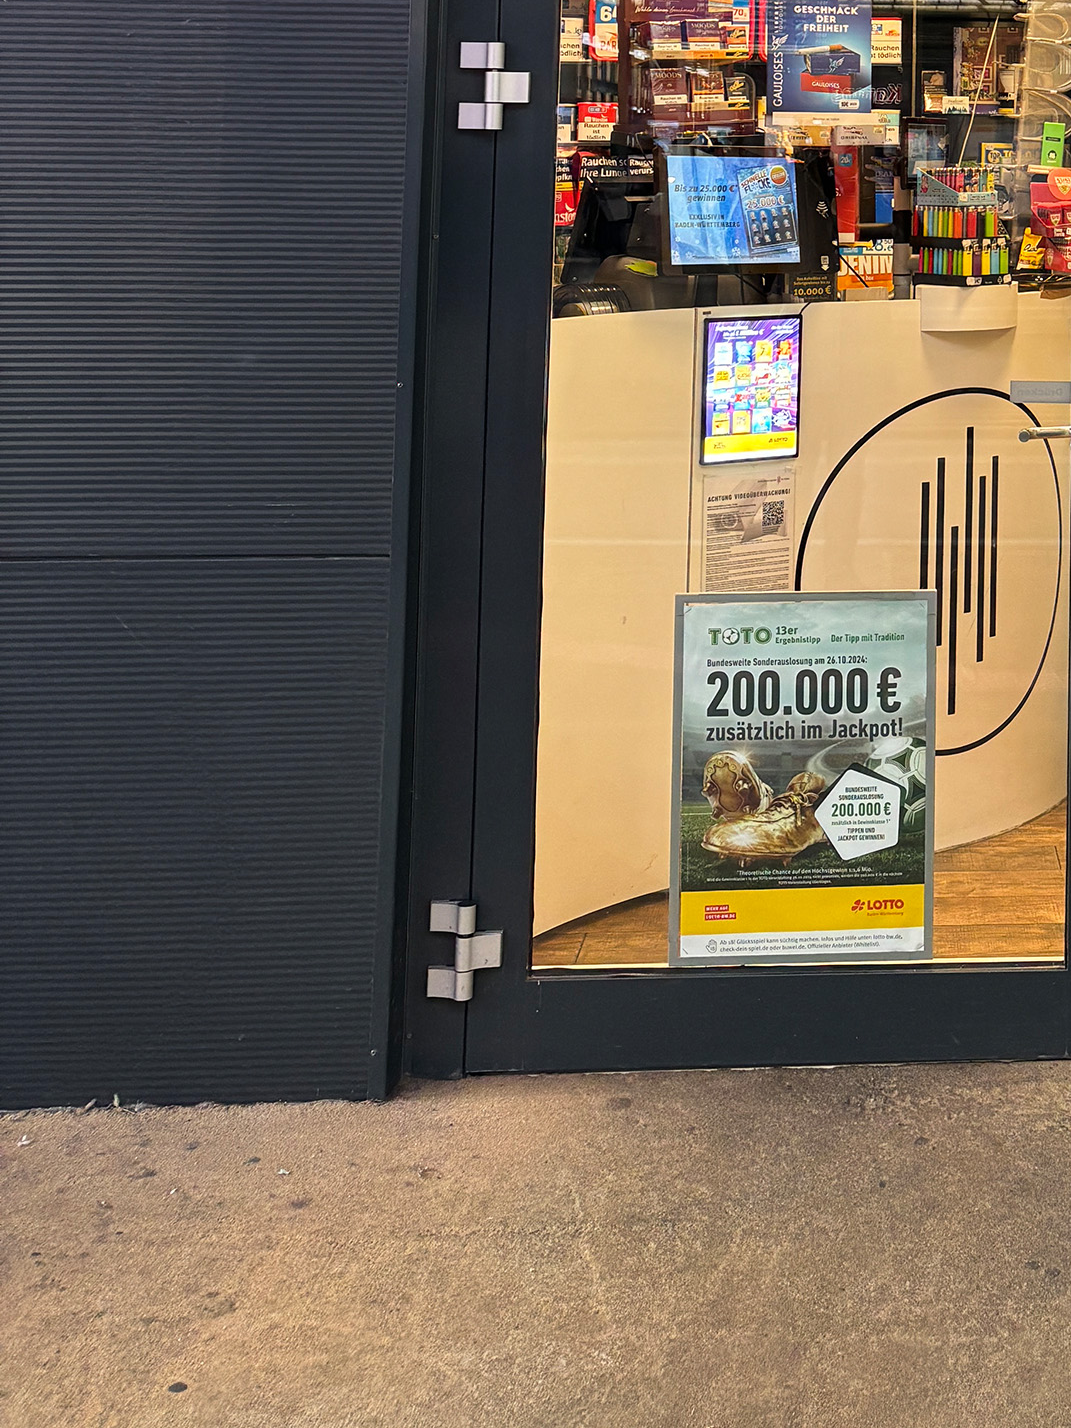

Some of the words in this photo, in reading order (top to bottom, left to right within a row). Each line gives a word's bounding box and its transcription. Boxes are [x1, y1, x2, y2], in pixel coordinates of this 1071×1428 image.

[794, 6, 858, 15] GESCHMACK
[816, 15, 836, 24] DER
[803, 24, 849, 33] FREIHEIT
[773, 51, 784, 107] GAULOISES
[687, 194, 726, 203] gewinnen
[793, 287, 824, 296] 10.000
[708, 626, 772, 646] TOTO
[776, 626, 798, 636] 13er
[776, 636, 821, 645] Ergebnistipp
[831, 634, 845, 642] Der
[846, 633, 860, 643] Tipp
[861, 633, 874, 642] mit
[874, 632, 905, 642] Tradition
[707, 658, 751, 668] Bundesweite
[753, 657, 813, 667] Sonderauslosung
[706, 667, 869, 717] 200.000
[876, 666, 902, 714] €
[706, 720, 795, 742] zusätzlich
[801, 721, 822, 739] im
[828, 718, 903, 742] Jackpot!
[831, 802, 881, 817] 200.000
[884, 802, 891, 815] €
[867, 899, 904, 910] LOTTO
